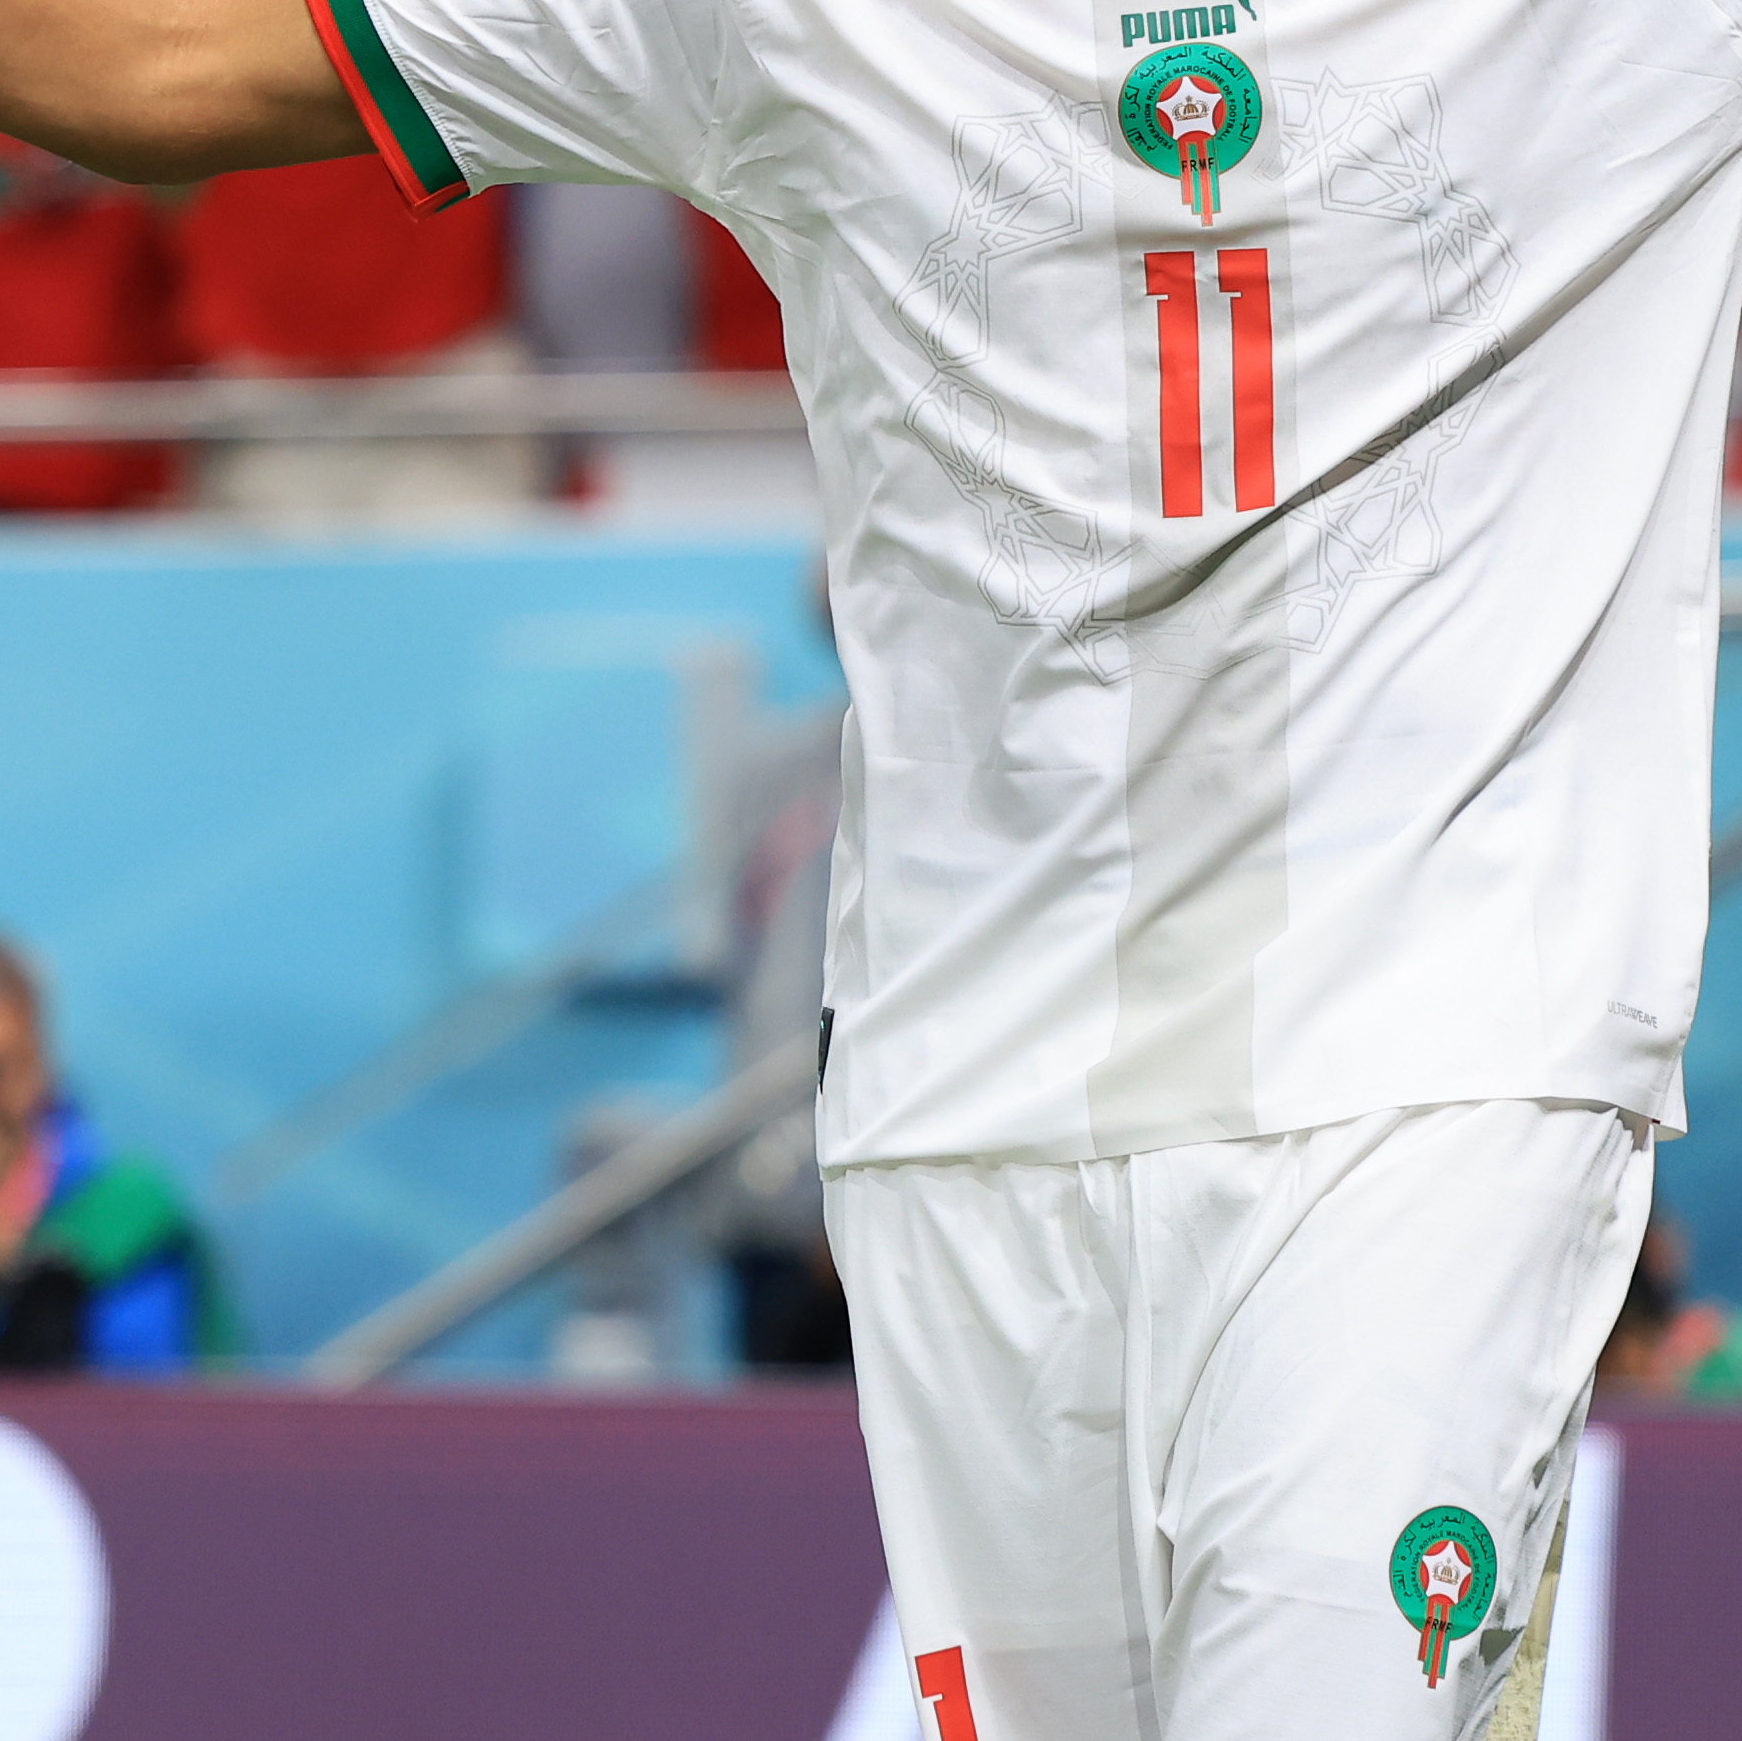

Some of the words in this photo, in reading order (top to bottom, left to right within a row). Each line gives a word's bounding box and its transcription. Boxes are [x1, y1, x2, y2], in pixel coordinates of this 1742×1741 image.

[1121, 4, 1236, 48] PUMA
[1146, 71, 1171, 101] ROYALE
[1172, 65, 1225, 87] MAROCAINE
[1222, 85, 1234, 99] DE
[1181, 157, 1215, 173] FRMF
[1144, 247, 1275, 518] 11
[1424, 1616, 1453, 1634] FRMF
